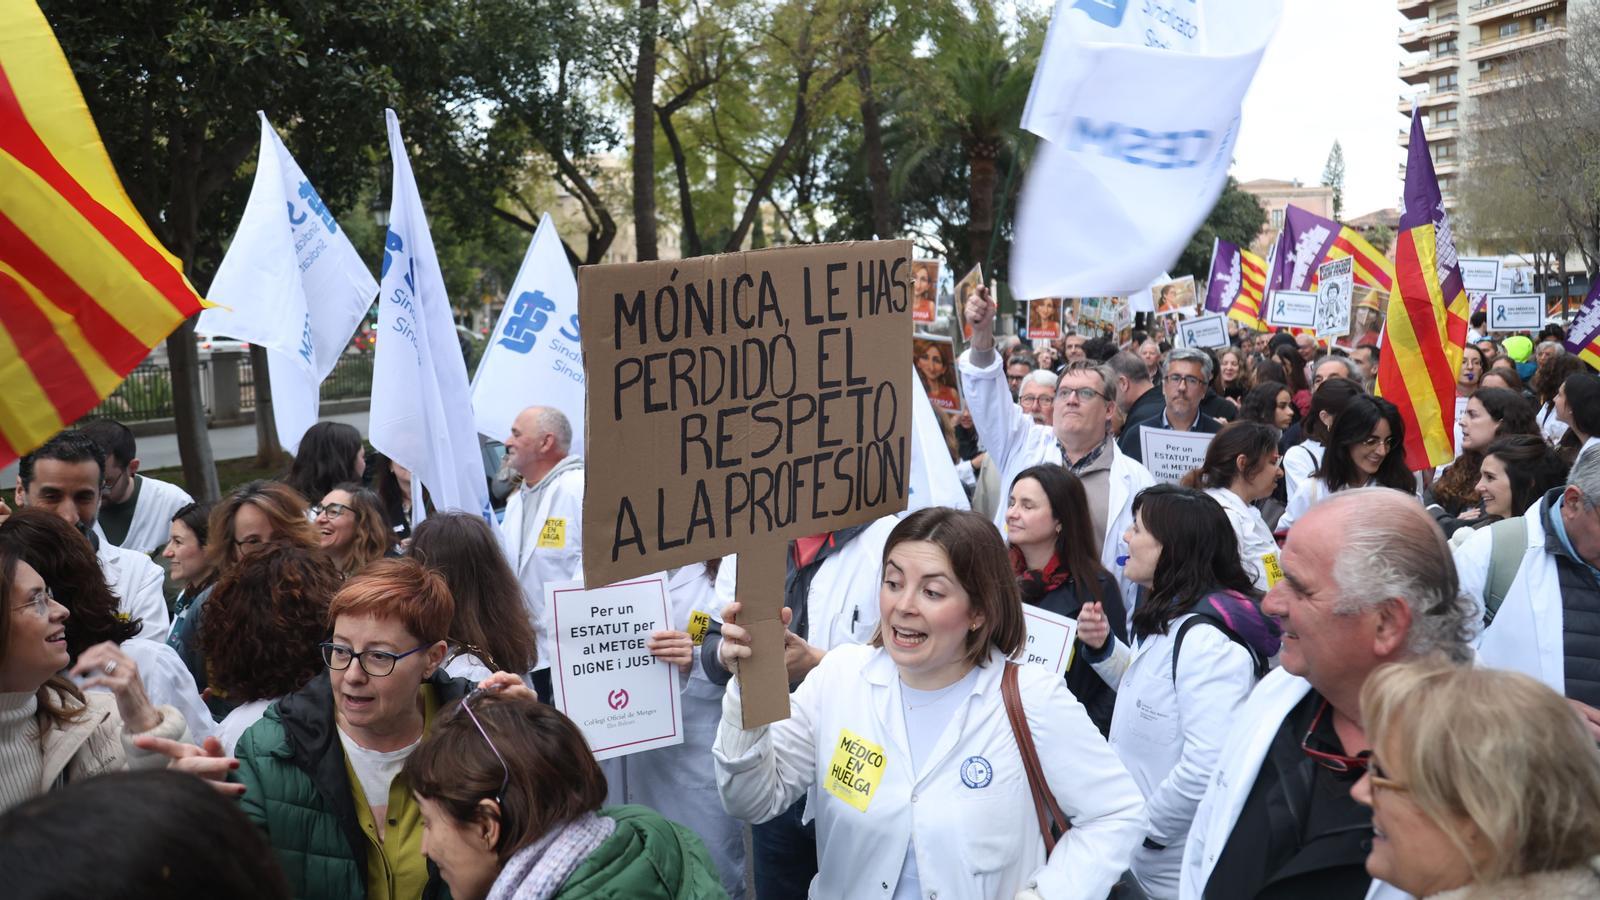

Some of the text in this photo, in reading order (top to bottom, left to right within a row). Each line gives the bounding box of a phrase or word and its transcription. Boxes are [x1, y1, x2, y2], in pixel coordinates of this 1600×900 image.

[804, 262, 848, 325] LE
[858, 257, 908, 318] HAS
[818, 327, 867, 390] EL
[681, 381, 897, 475] RESPETO
[1166, 444, 1180, 452] Per
[1154, 452, 1190, 462] ESTATUT
[1155, 471, 1180, 480] DIGNE
[612, 496, 646, 562] A
[658, 479, 716, 551] LA
[591, 605, 634, 618] Per un
[693, 615, 708, 626] ME
[570, 621, 655, 638] ESTATUT per
[700, 626, 707, 635] E
[583, 638, 645, 655] al METGE
[1028, 635, 1035, 644] n
[573, 654, 657, 676] DIGNE i JUST
[1028, 653, 1048, 665] per
[840, 736, 883, 768] MÉDICO
[846, 756, 865, 775] EN
[831, 763, 871, 796] HUELGA
